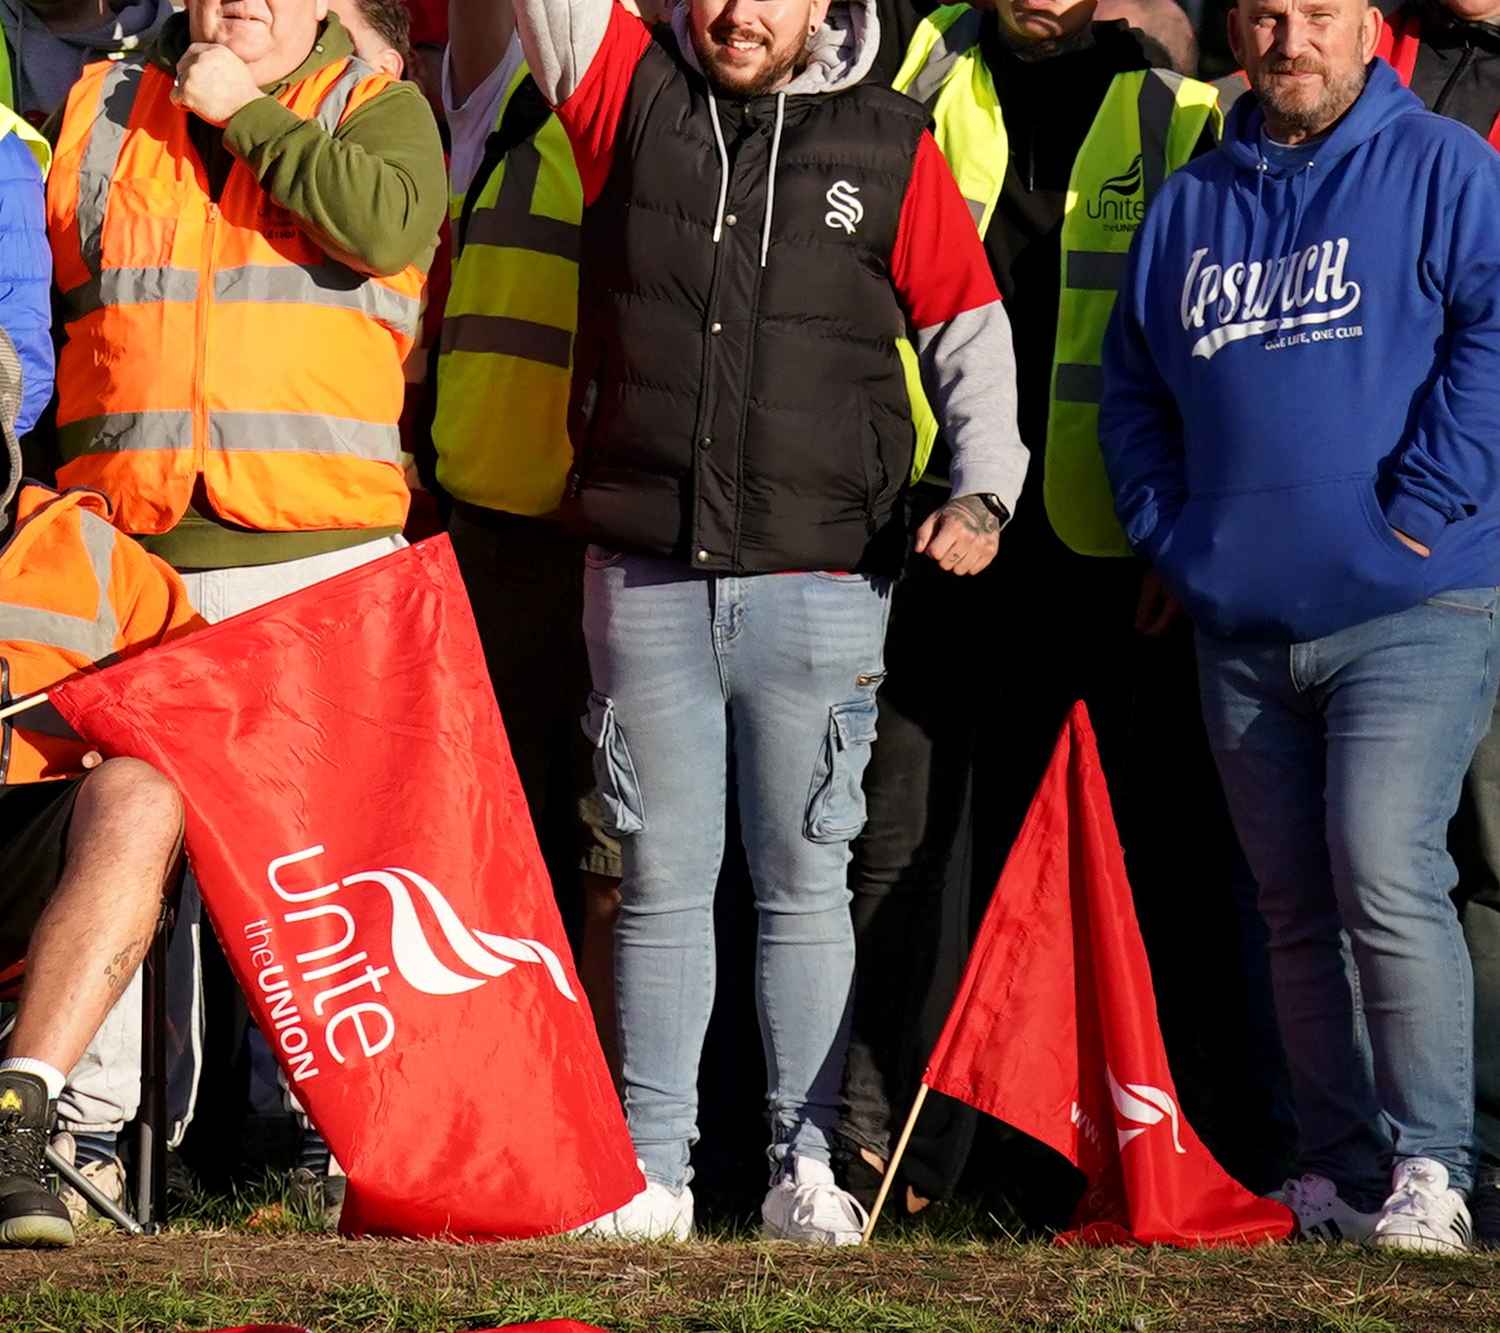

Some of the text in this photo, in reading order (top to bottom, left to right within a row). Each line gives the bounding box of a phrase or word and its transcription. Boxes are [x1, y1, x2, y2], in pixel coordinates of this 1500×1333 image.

[1312, 327, 1334, 341] ONE
[1335, 325, 1364, 337] CLUB
[243, 919, 320, 1082] theUNION
